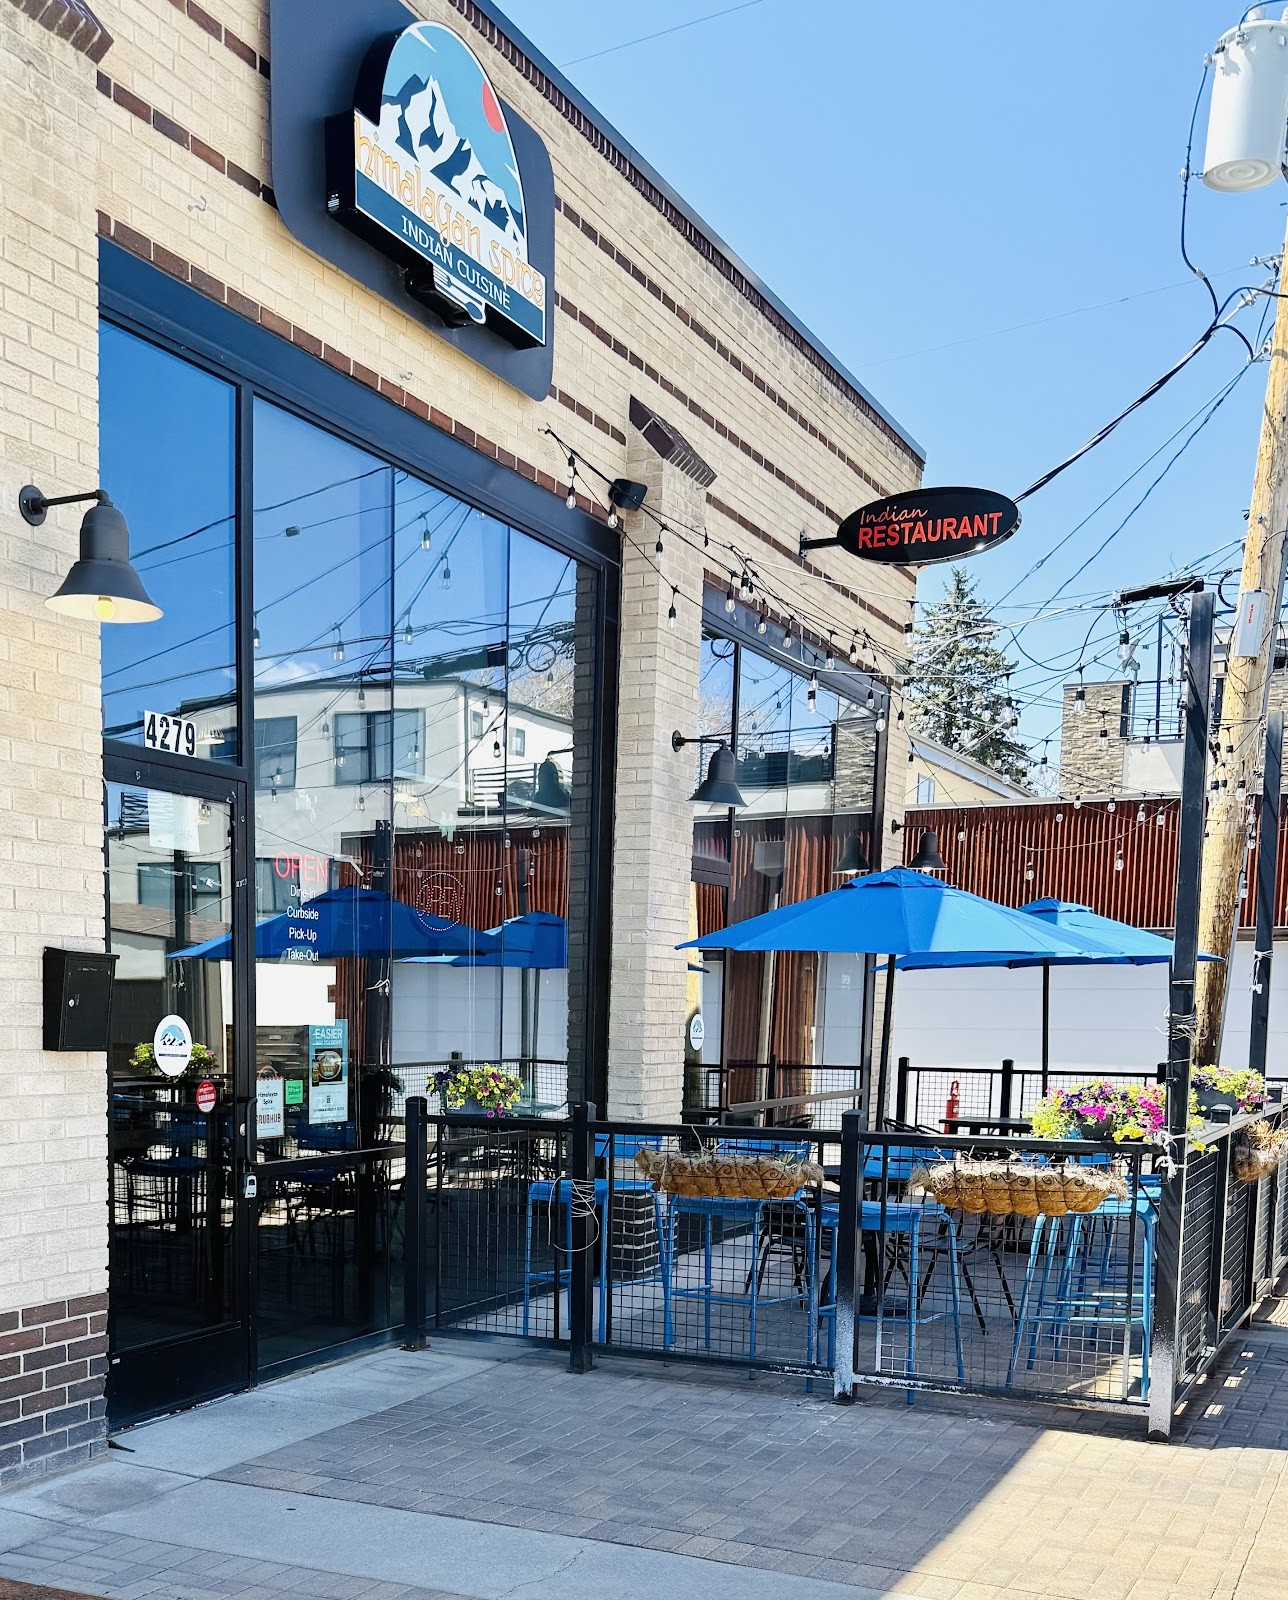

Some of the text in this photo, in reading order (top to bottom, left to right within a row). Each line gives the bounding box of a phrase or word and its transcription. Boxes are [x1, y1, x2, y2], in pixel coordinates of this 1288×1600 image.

[355, 114, 544, 307] himalayan spice
[401, 215, 511, 311] INDIAN CUISINE
[858, 512, 1003, 549] RESTAURANT
[859, 504, 929, 525] Indian
[146, 714, 195, 756] 4279
[273, 850, 328, 883] OPEN
[286, 905, 319, 920] Curbside
[288, 927, 317, 943] Pick-Up
[286, 948, 319, 962] Take-Out
